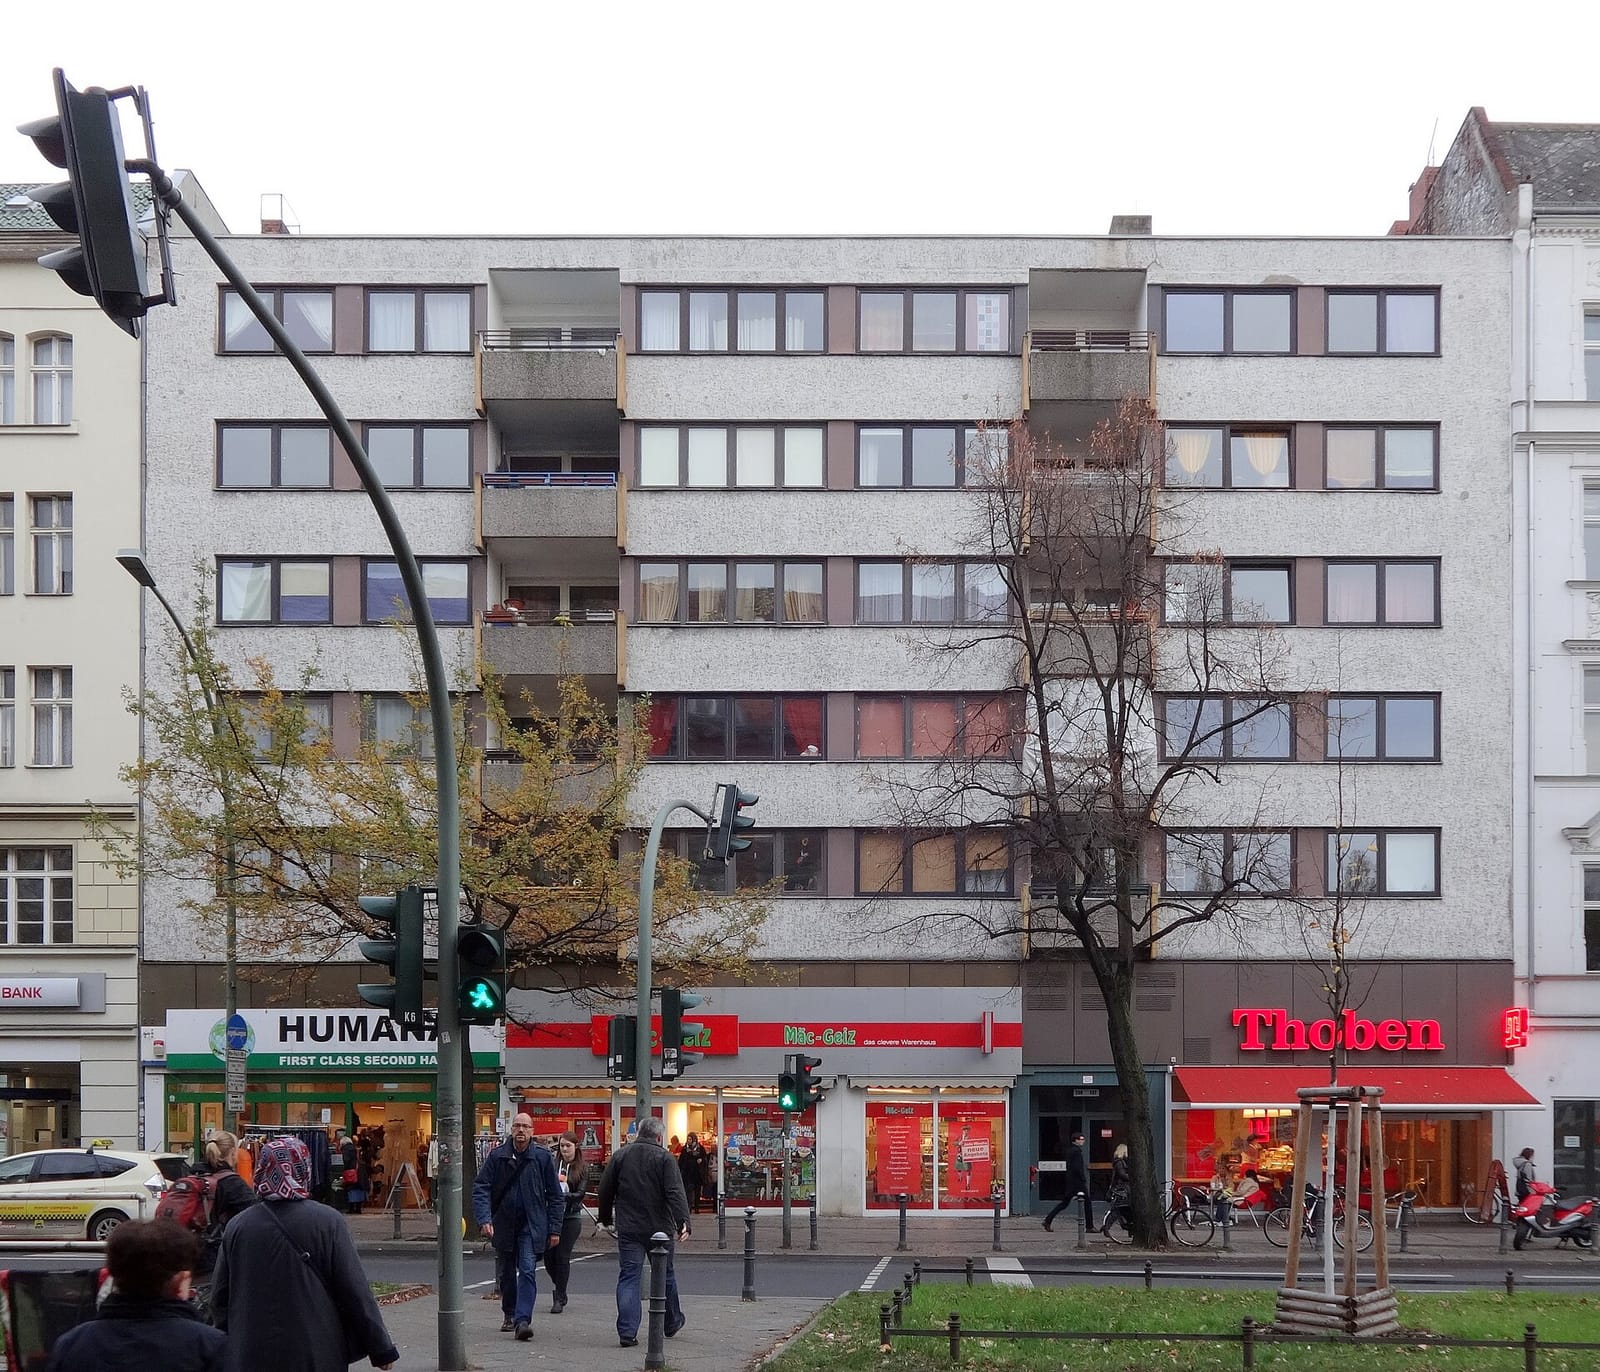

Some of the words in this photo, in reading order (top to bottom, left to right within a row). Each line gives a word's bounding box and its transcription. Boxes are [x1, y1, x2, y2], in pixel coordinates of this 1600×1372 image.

[2, 987, 42, 998] BANK
[404, 1011, 416, 1022] K6
[279, 1016, 438, 1042] HUMAN
[784, 1025, 856, 1045] Mäc-Geiz
[1232, 1008, 1445, 1050] Thoben
[279, 1056, 317, 1066] FIRST
[320, 1055, 361, 1066] CLASS
[364, 1055, 417, 1066] SECOND
